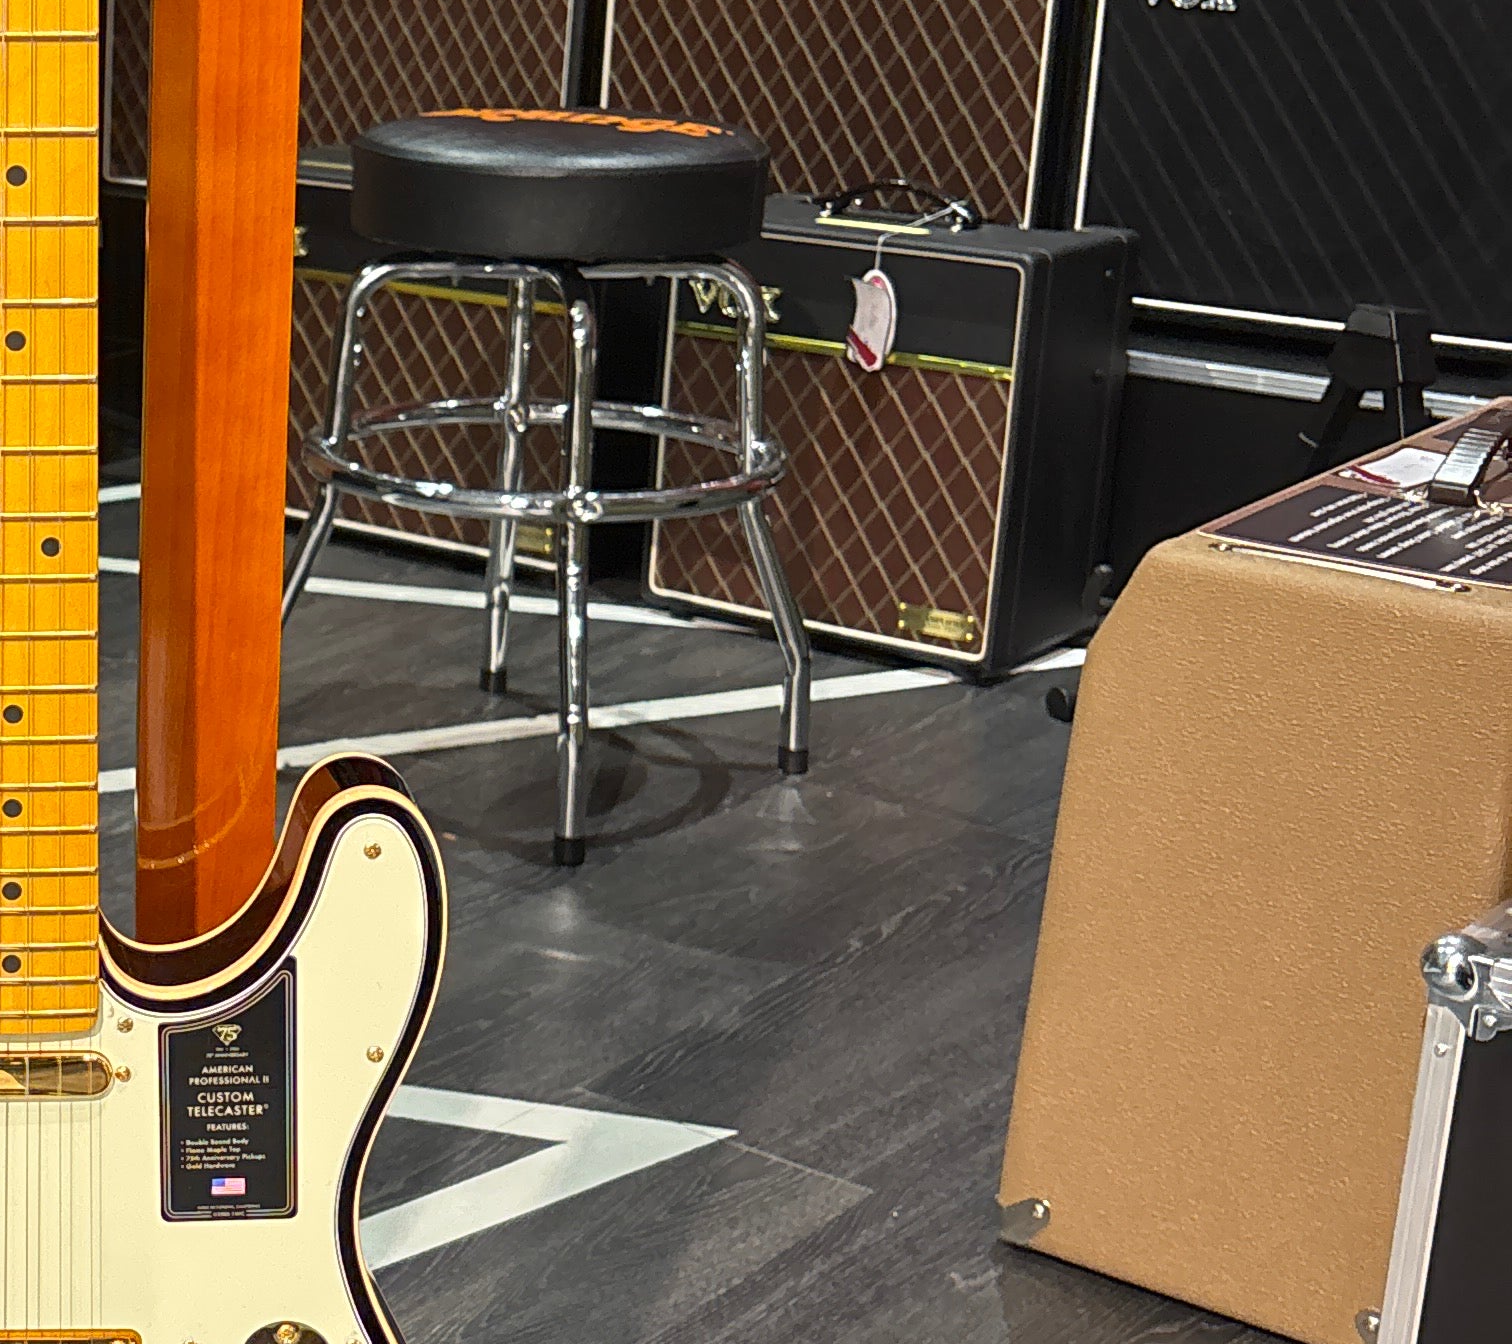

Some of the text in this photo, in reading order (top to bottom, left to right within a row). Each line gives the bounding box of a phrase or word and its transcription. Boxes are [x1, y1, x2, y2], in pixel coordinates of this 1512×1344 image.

[217, 1026, 237, 1041] 75
[201, 1065, 253, 1074] AMERICAN
[188, 1076, 260, 1085] PROFESSIONAL
[197, 1091, 254, 1103] CUSTOM
